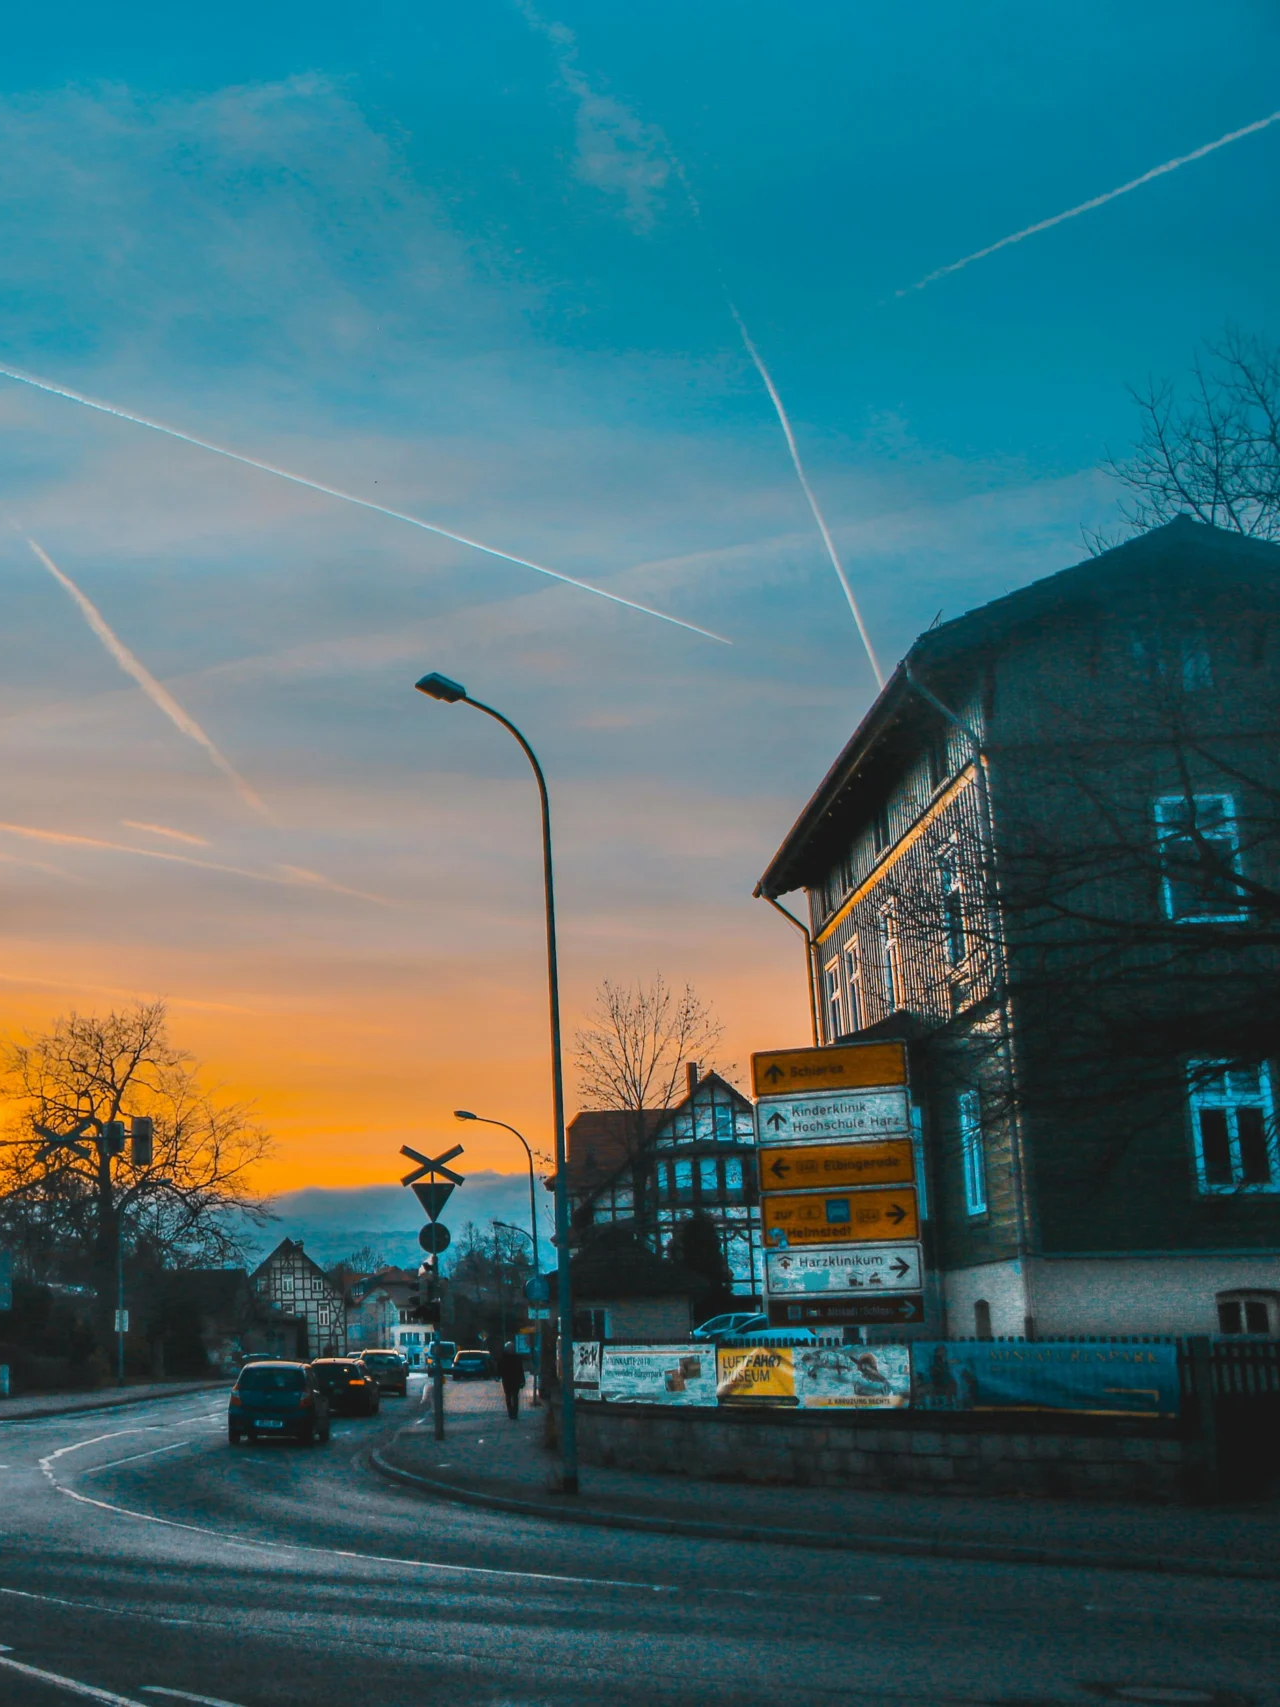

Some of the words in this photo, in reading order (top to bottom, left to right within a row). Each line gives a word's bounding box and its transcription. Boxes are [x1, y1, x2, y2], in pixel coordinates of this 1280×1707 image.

[792, 1102, 867, 1117] Kinderklinik
[793, 1117, 865, 1132] Hochschule
[870, 1115, 900, 1127] Harz
[774, 1209, 793, 1221] zur
[787, 1226, 852, 1240] Helmstedt
[799, 1254, 884, 1269] Harzklinikum
[723, 1354, 781, 1369] LUFTFAHRT
[723, 1369, 770, 1383] MUSEUM
